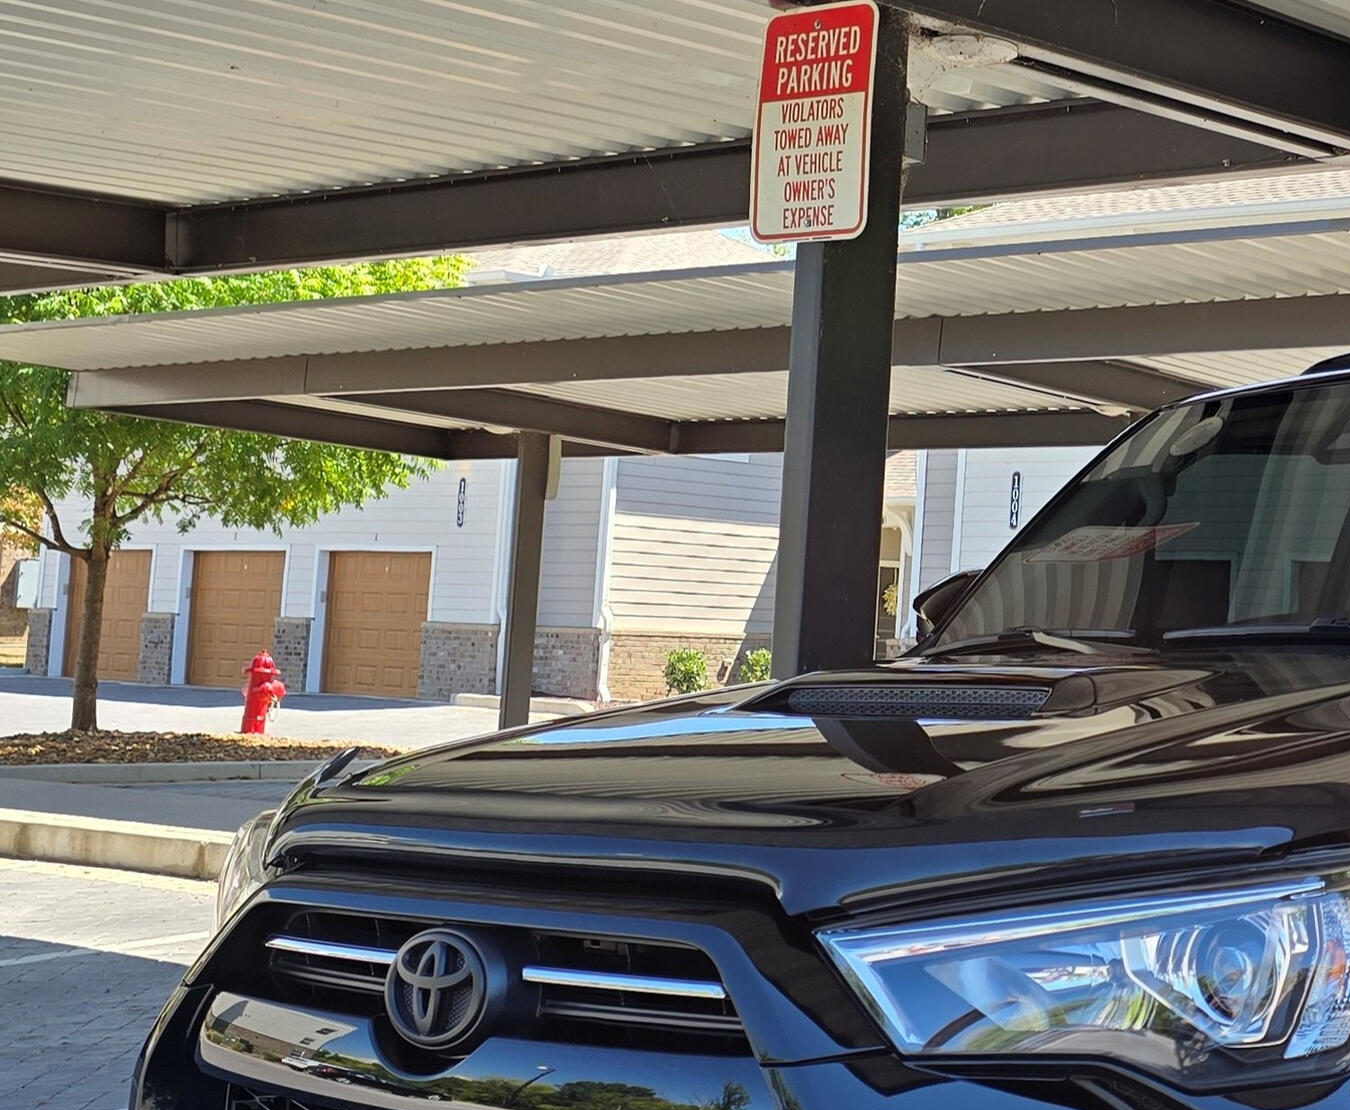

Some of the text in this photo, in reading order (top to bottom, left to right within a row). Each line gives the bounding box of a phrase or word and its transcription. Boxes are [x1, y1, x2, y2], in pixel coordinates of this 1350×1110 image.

[775, 25, 861, 64] RESERVED
[777, 60, 853, 96] PARKING
[781, 97, 845, 124] VIOLATORS
[774, 123, 849, 151] TOWED AWAY
[777, 151, 843, 177] AT VEHICLE
[784, 178, 836, 202] OWNER'S
[1010, 475, 1019, 527] 1004
